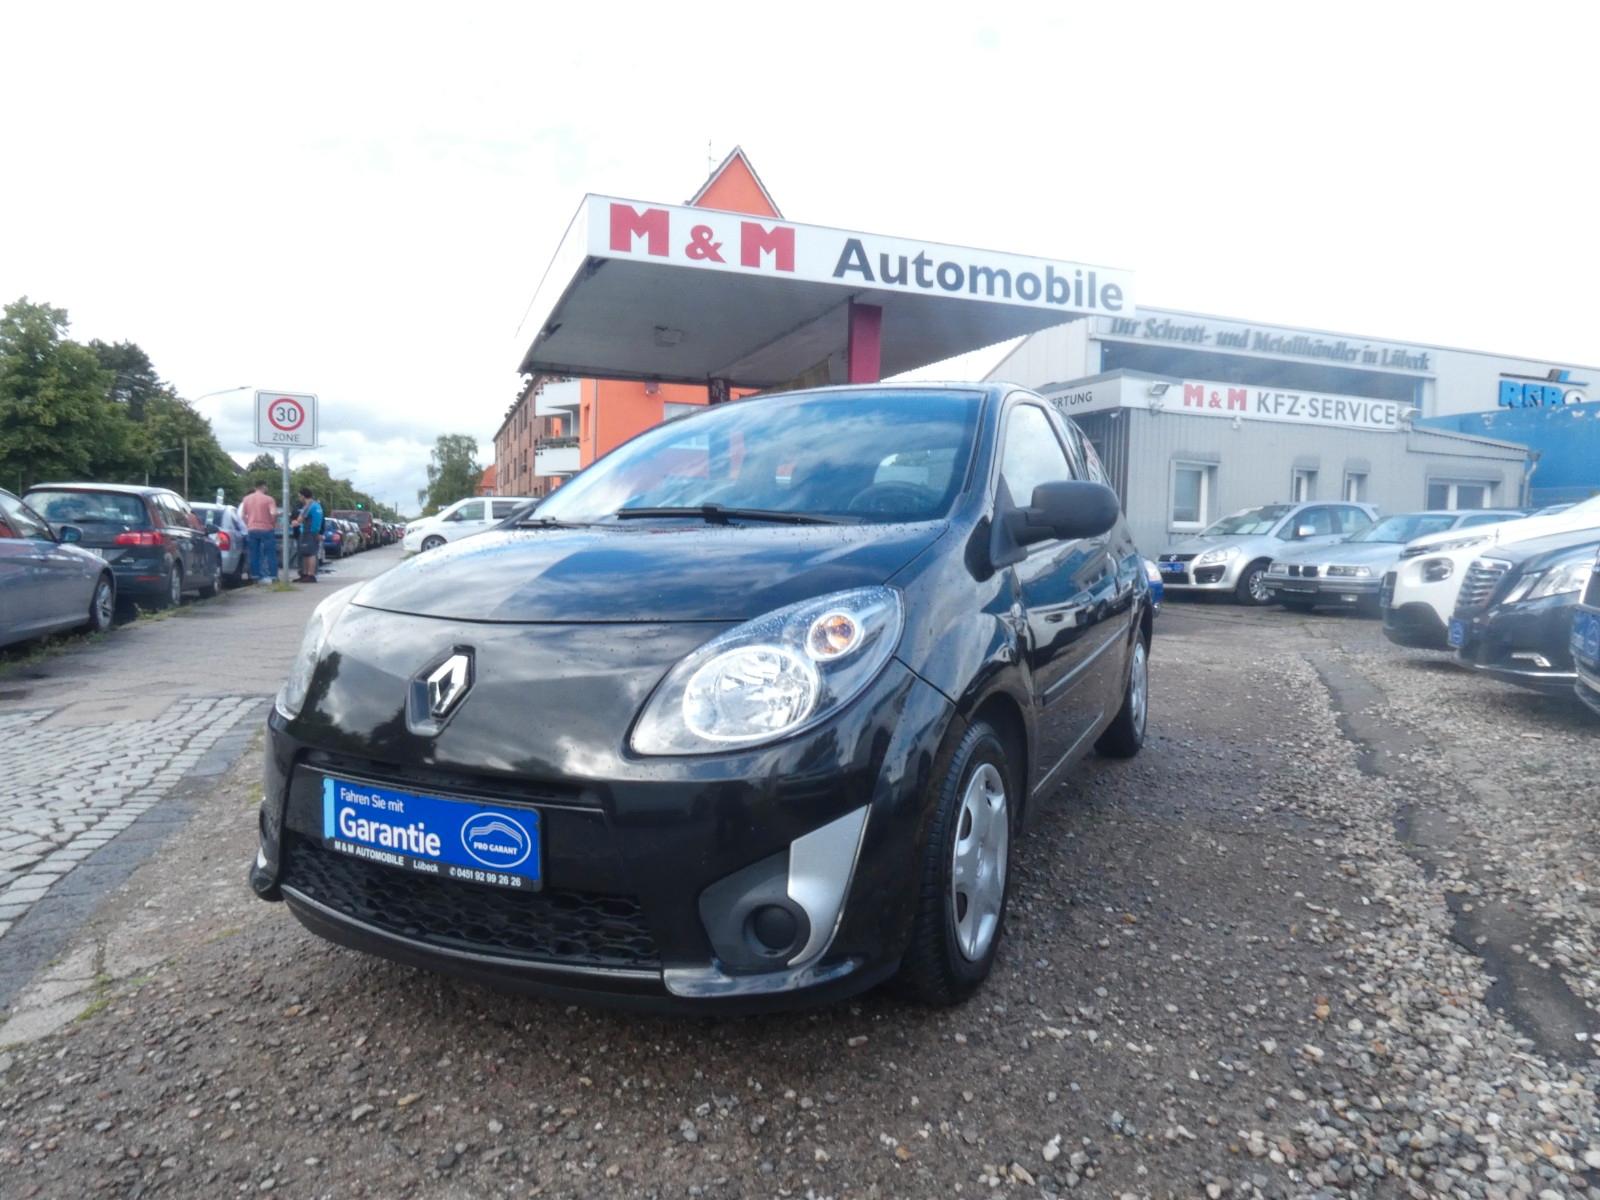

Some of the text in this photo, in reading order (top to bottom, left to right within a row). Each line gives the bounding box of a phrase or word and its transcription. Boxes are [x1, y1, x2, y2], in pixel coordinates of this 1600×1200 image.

[832, 238, 1123, 311] Automobile
[1216, 329, 1250, 348] und
[1362, 345, 1378, 364] in
[1381, 348, 1430, 370] Lübeck
[276, 406, 297, 423] 30
[272, 432, 301, 442] ZONE
[340, 787, 404, 813] Fahren Sie mit
[339, 807, 441, 857] Garantie
[473, 841, 518, 855] PRO GARANT
[355, 846, 405, 866] AUTOMOBILE
[413, 859, 439, 873] Lübeck
[457, 868, 473, 879] 0451
[475, 871, 485, 881] 92
[486, 873, 497, 883] 99
